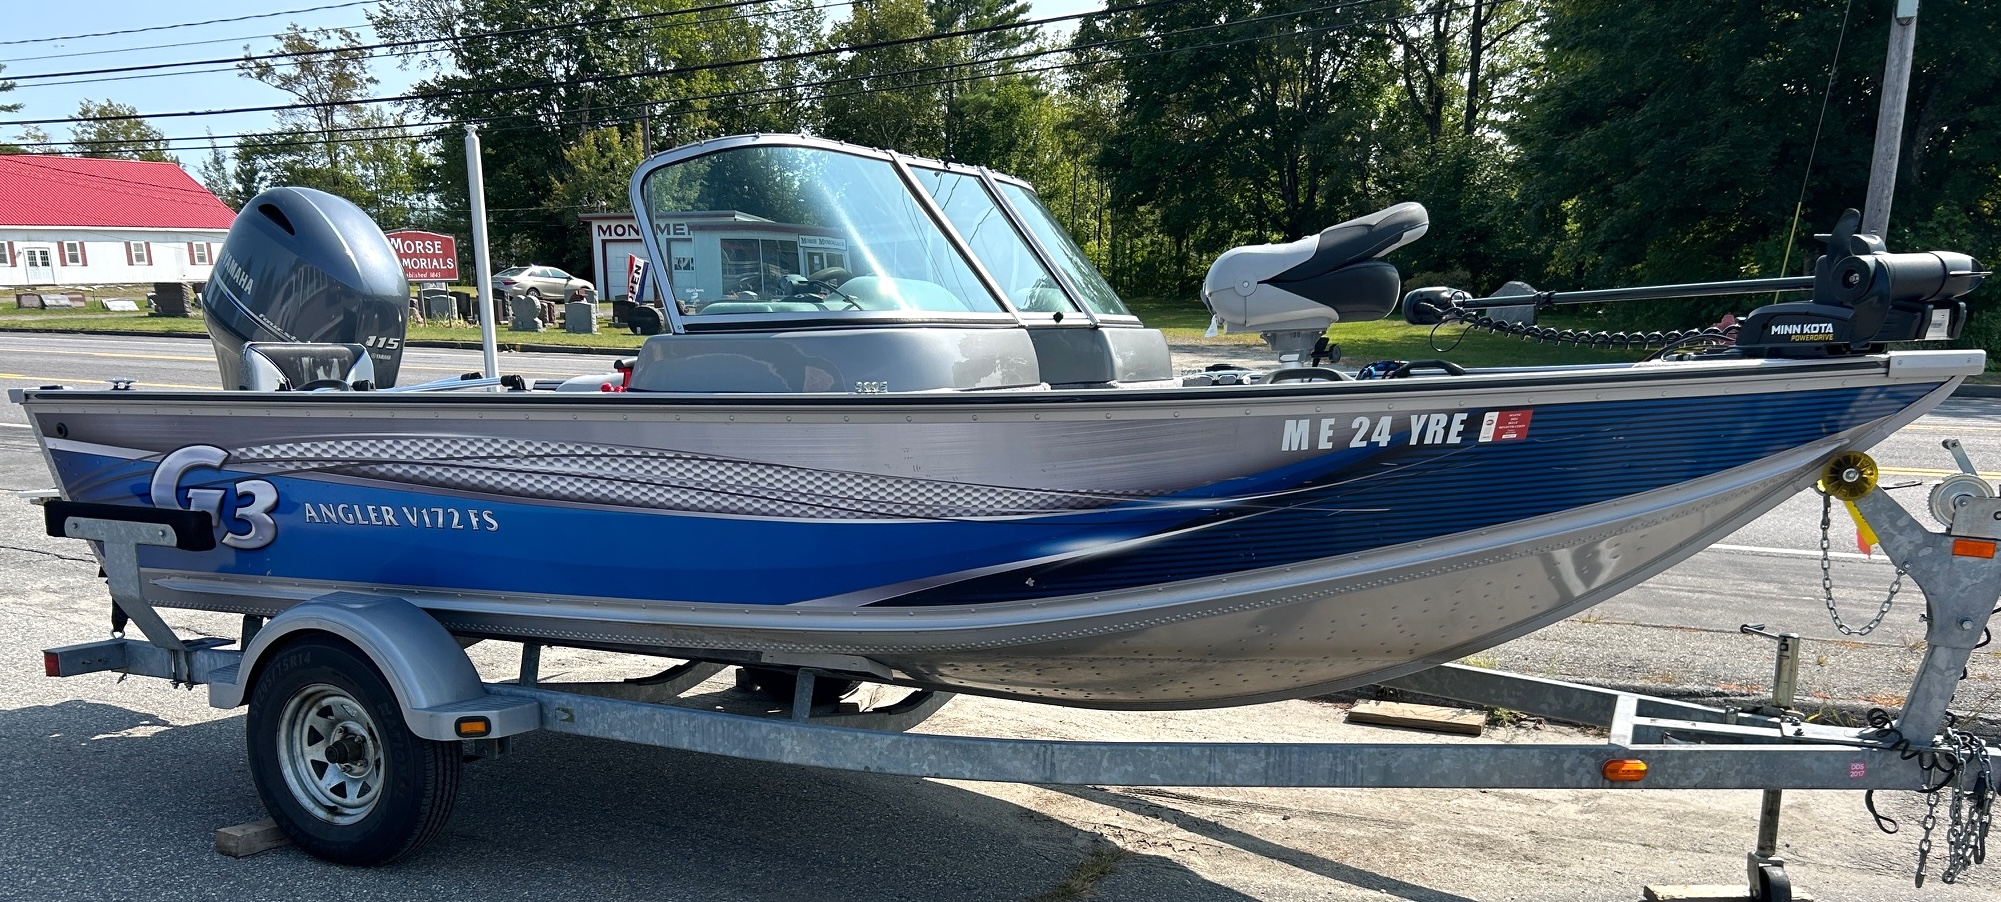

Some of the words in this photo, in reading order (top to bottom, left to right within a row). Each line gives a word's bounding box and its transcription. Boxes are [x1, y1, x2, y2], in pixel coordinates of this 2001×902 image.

[597, 223, 691, 238] MONME
[390, 238, 443, 254] MORSE
[402, 257, 455, 270] MORIALS
[223, 250, 254, 295] YAMAHA
[1771, 323, 1802, 335] MINN
[1803, 322, 1834, 334] KOTA
[365, 335, 401, 350] 115
[1790, 333, 1834, 342] POWERDRIVE
[1281, 418, 1336, 451] ME
[1349, 416, 1393, 448] 24
[1408, 412, 1469, 446] YRE
[150, 443, 279, 550] G3
[304, 502, 400, 527] ANGLER
[401, 505, 464, 530] V172
[467, 508, 500, 532] FS
